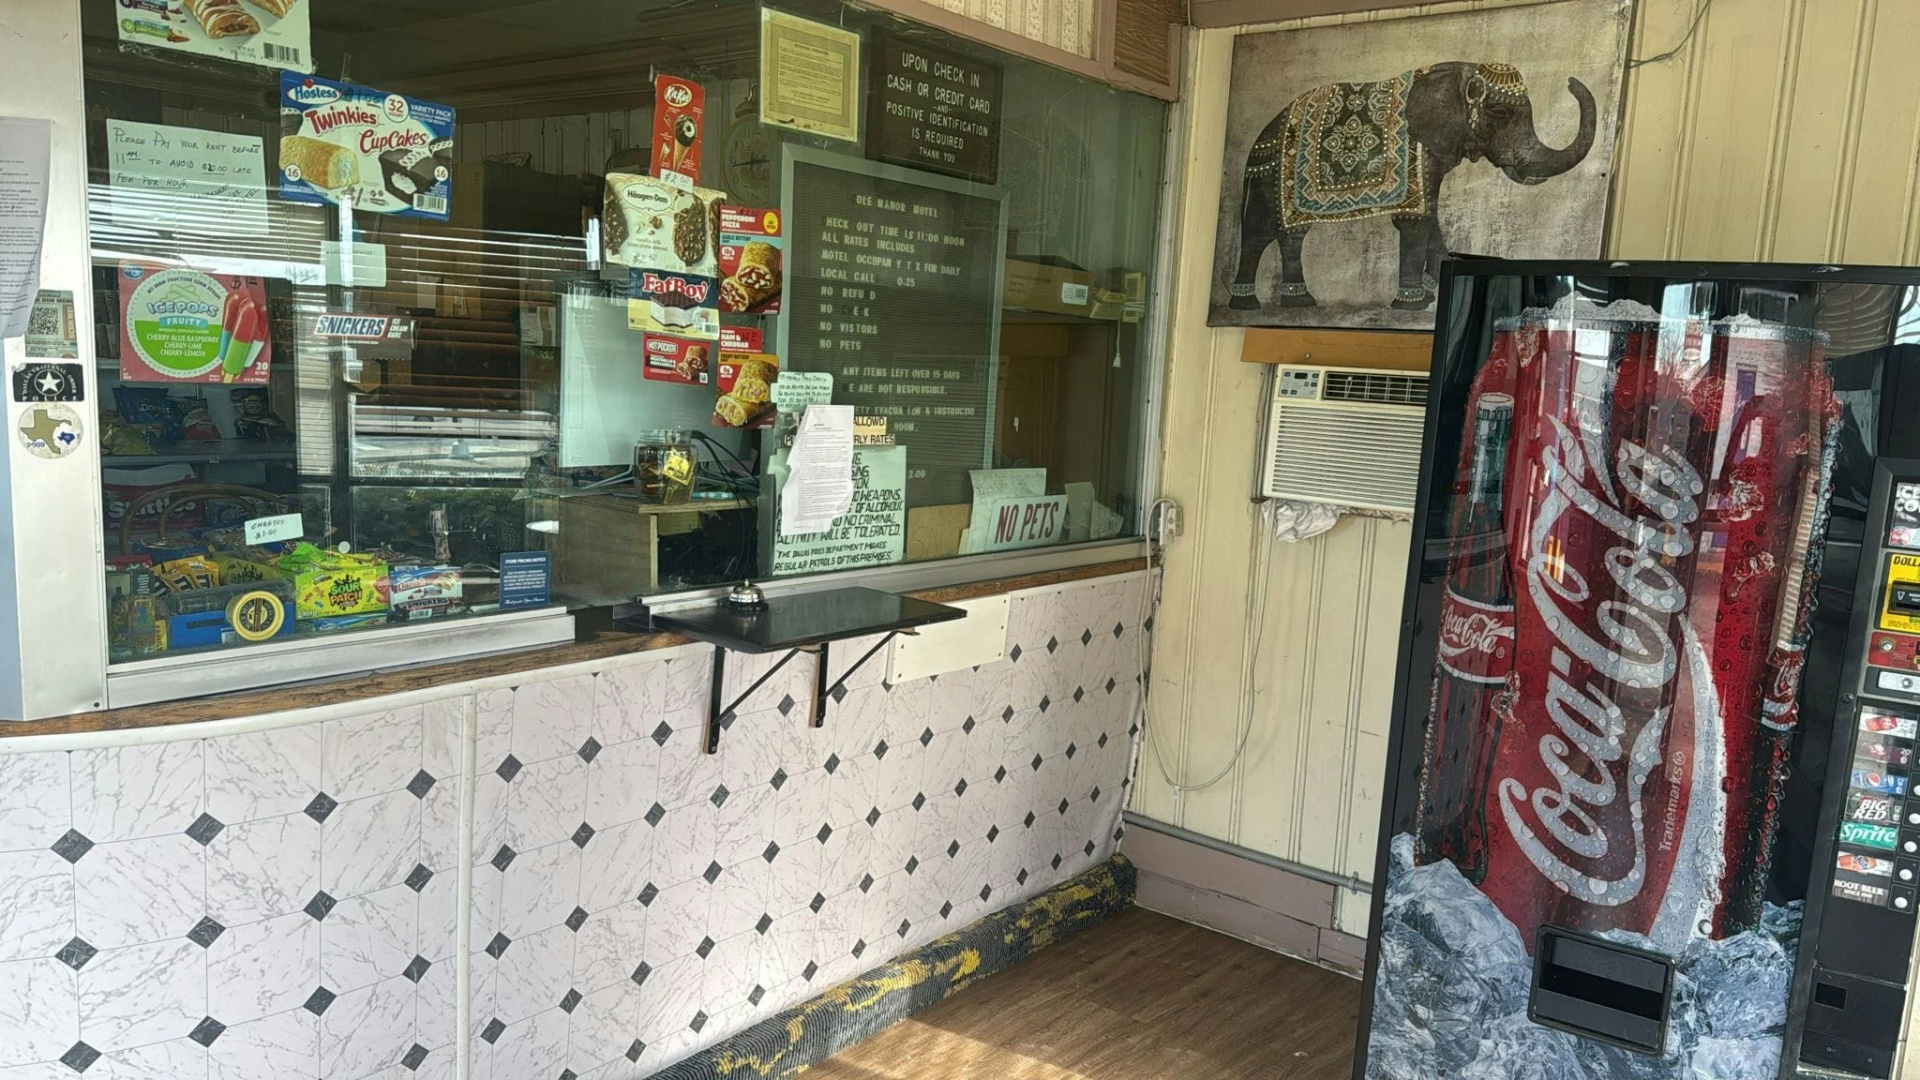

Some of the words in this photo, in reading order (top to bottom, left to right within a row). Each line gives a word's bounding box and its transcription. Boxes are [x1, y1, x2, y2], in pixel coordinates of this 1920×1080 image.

[902, 52, 928, 74] UPON
[934, 61, 965, 85] CHECK
[970, 73, 980, 88] IN
[294, 88, 338, 100] Hostess
[887, 73, 912, 93] CASH
[917, 83, 929, 98] OR
[934, 86, 964, 108] CREDIT
[969, 98, 990, 114] CARD
[388, 97, 405, 114] 32
[304, 106, 378, 135] Twinkies
[886, 101, 924, 122] POSITIVE
[929, 112, 988, 138] IDENTIFICATION
[113, 127, 146, 145] PLEASE
[153, 131, 170, 149] PAY
[180, 136, 199, 150] YOUR
[206, 144, 227, 153] RENT
[359, 129, 428, 154] CupCakes
[911, 127, 920, 140] IS
[925, 131, 964, 150] REQUIRED
[919, 146, 939, 160] THANK
[943, 151, 956, 164] YOU
[148, 158, 161, 166] TO
[170, 160, 194, 169] AVOID
[233, 167, 252, 175] LATE
[287, 168, 299, 178] 16
[435, 168, 447, 178] 16
[116, 172, 134, 183] FEE
[143, 177, 160, 187] PER
[856, 195, 873, 206] OLE
[877, 199, 905, 212] MANOR
[913, 205, 938, 217] MOTEL
[857, 222, 874, 233] OUT
[880, 225, 899, 237] TIME
[904, 229, 914, 240] IS
[944, 235, 965, 246] NOON
[821, 232, 839, 244] ALL
[844, 235, 869, 248] RATES
[877, 239, 915, 254] INCLUDES
[821, 250, 849, 263] MOTEL
[924, 263, 938, 274] FOR
[821, 267, 847, 280] LOCAL
[854, 271, 875, 283] CALL
[821, 286, 833, 296] NO
[147, 301, 175, 314] ICE
[176, 301, 219, 317] POPS
[820, 304, 833, 314] NO
[166, 317, 202, 326] FRUITY
[316, 316, 386, 336] SNICKERS
[820, 321, 832, 332] NO
[820, 338, 832, 349] NO
[840, 340, 861, 350] PETS
[256, 362, 268, 370] 20
[843, 366, 860, 377] ANY
[863, 367, 887, 378] ITEMS
[891, 368, 910, 378] LEFT
[912, 370, 930, 379] OVER
[943, 370, 961, 380] DAYS
[858, 384, 873, 393] ARE
[878, 384, 894, 393] NOT
[870, 435, 895, 445] RATES
[1895, 498, 1920, 512] CO
[844, 514, 857, 526] NO
[858, 513, 896, 525] CRIMINAL
[994, 504, 1020, 545] NO
[1019, 501, 1059, 541] PETS
[841, 527, 850, 540] BE
[774, 560, 808, 571] REGULAR
[809, 557, 836, 568] PATROLS
[331, 582, 361, 595] SOUR
[330, 590, 363, 604] PATCH
[1860, 799, 1888, 812] BIG
[1854, 808, 1887, 820] RED
[1841, 821, 1896, 844] Sprite
[1834, 879, 1860, 891] ROOT
[1861, 884, 1884, 896] BEER
